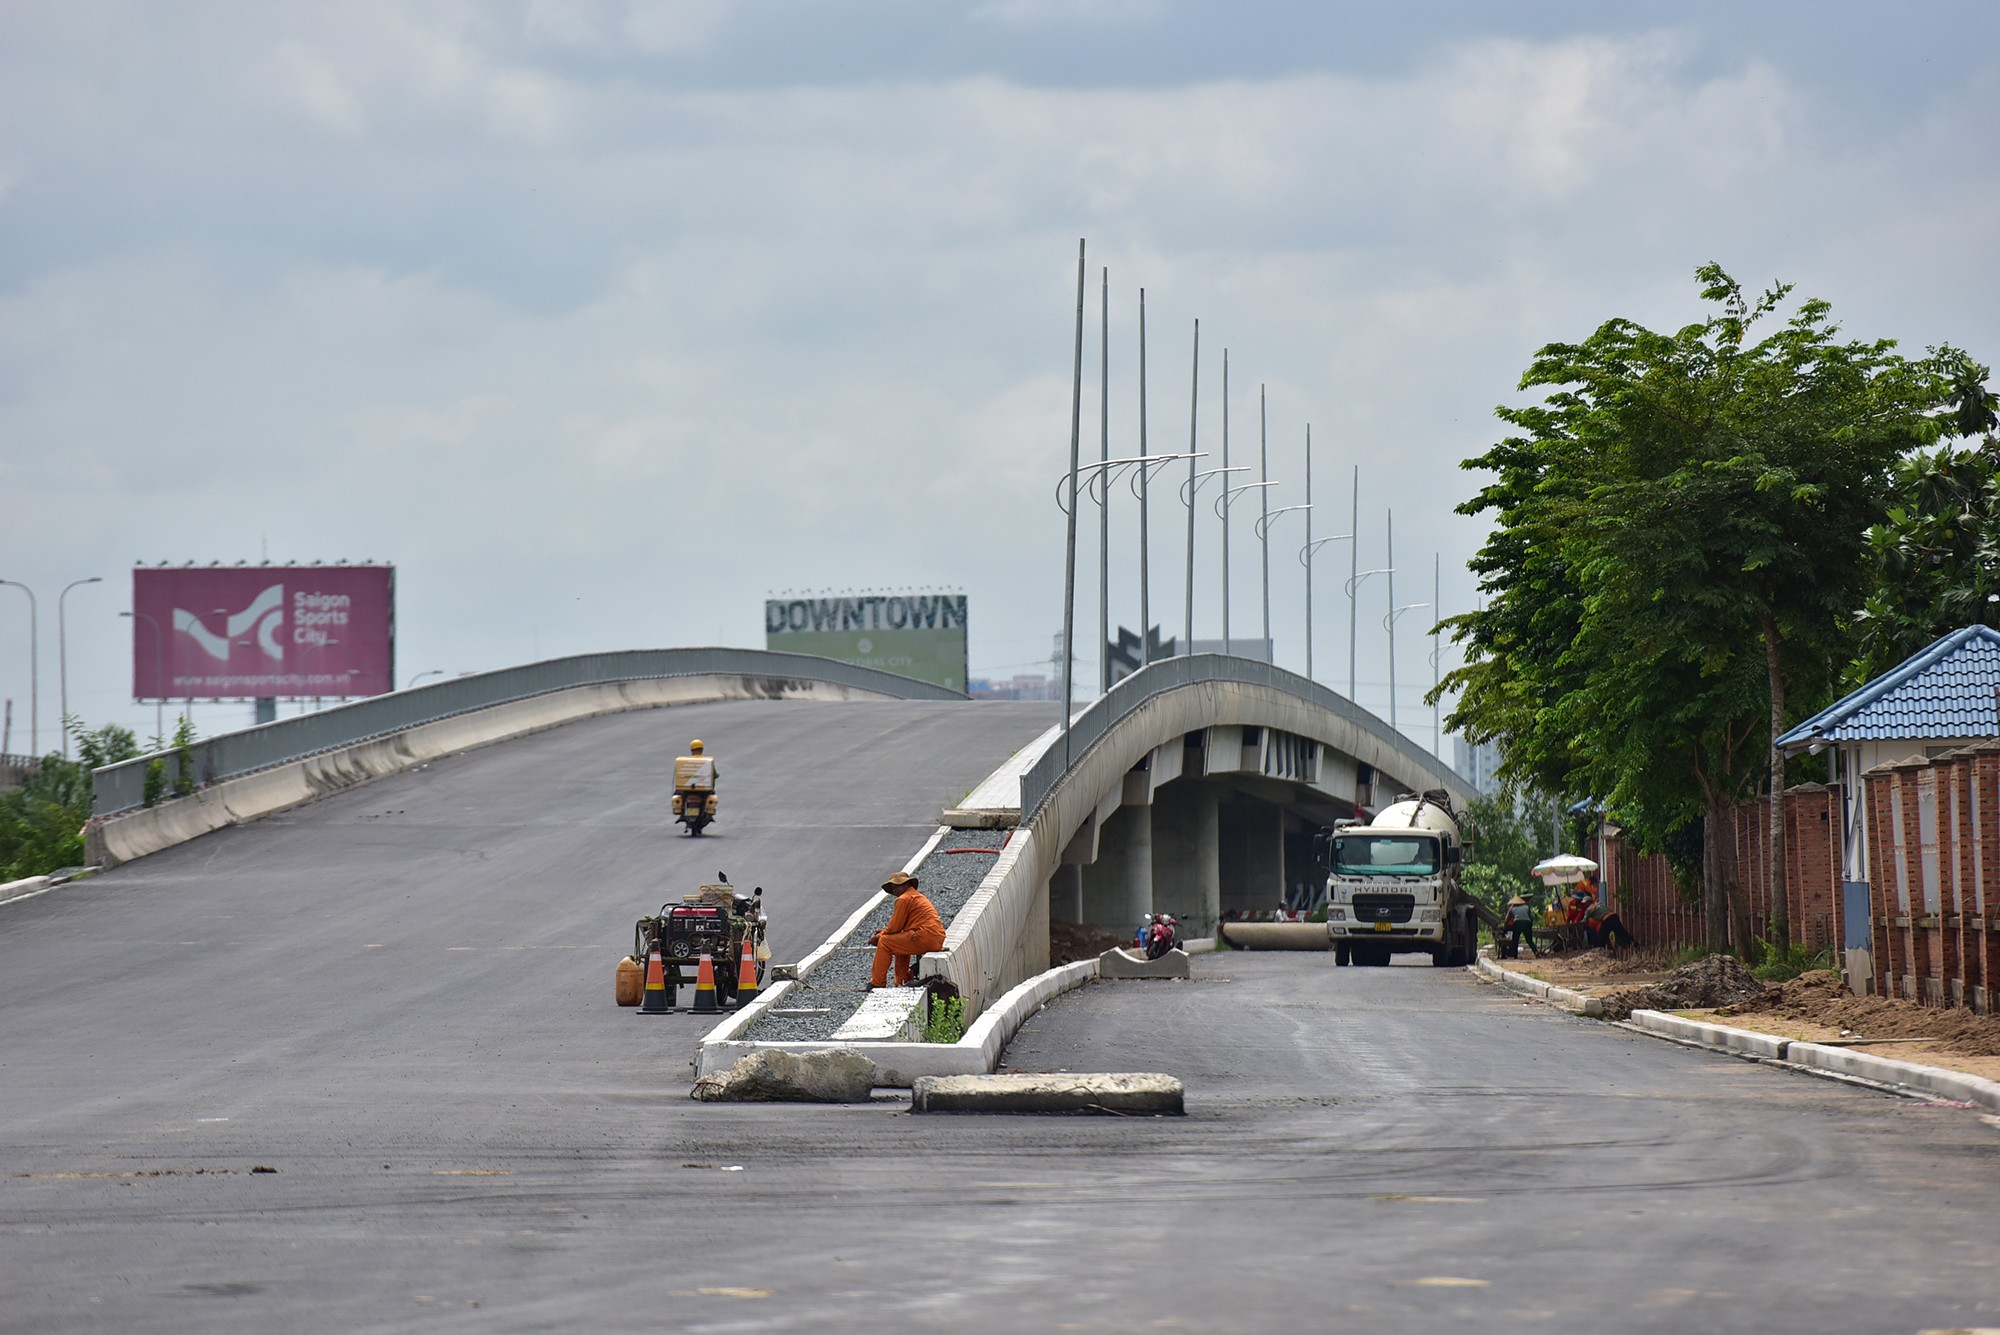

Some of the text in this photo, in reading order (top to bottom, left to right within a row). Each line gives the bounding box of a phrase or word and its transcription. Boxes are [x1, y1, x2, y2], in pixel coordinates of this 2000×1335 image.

[293, 591, 350, 611] Saigon
[294, 608, 349, 626] Sports
[766, 595, 967, 633] DOWNTOWN
[293, 627, 328, 646] City
